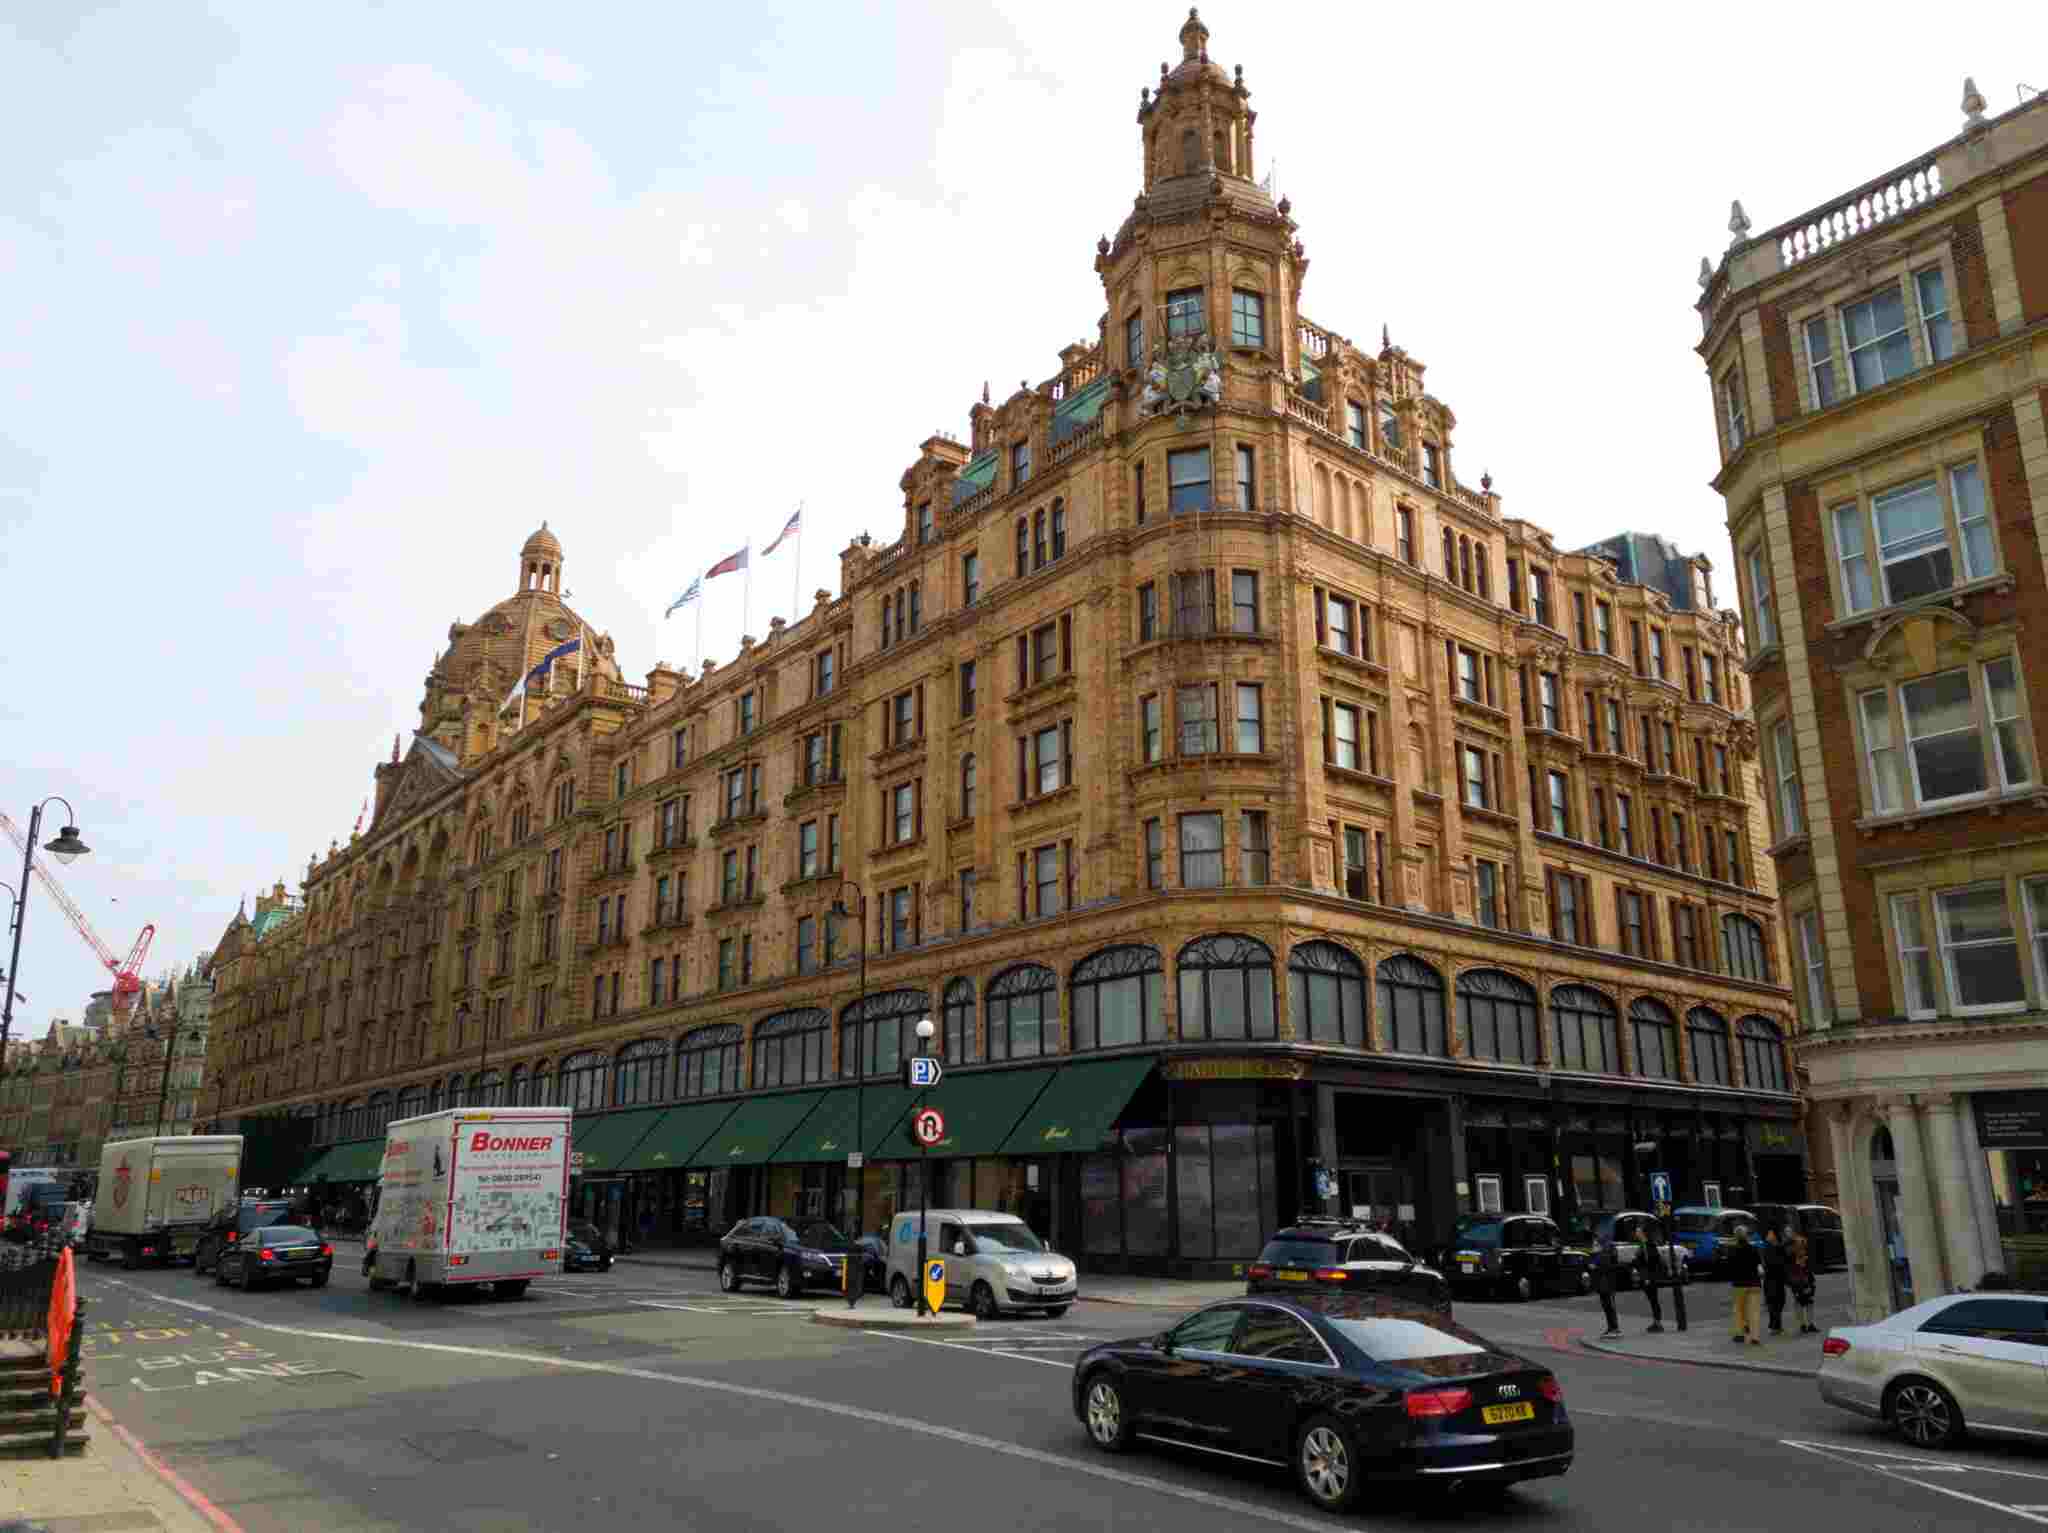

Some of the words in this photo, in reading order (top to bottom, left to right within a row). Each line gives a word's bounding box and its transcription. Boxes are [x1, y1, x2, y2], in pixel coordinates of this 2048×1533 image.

[914, 1061, 926, 1081] P
[470, 1131, 553, 1152] BONNER
[136, 1347, 277, 1370] BUS
[130, 1360, 336, 1391] LANE
